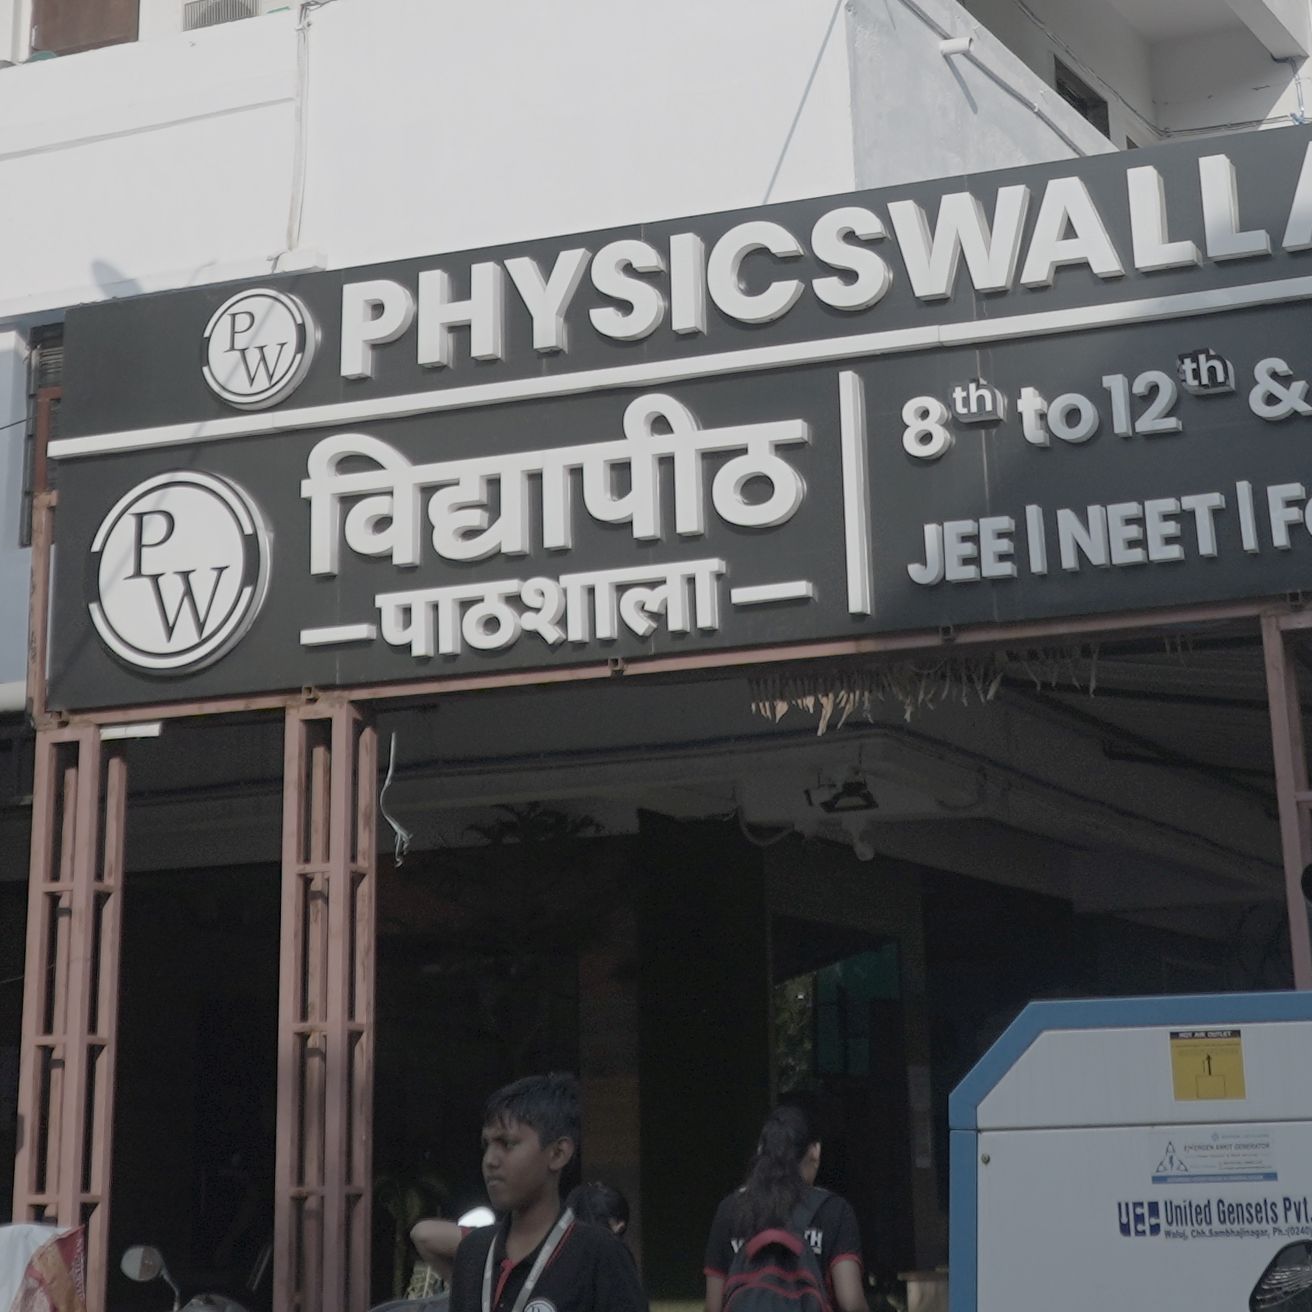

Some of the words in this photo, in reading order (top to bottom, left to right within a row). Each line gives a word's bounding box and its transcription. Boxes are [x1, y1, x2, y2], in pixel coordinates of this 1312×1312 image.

[901, 381, 1002, 460] 8th
[301, 392, 811, 577] विद्यापीठ
[1056, 493, 1226, 572] NEET
[375, 558, 727, 659] पाठशाला
[1164, 1199, 1214, 1228] United
[1216, 1198, 1280, 1226] Gensets
